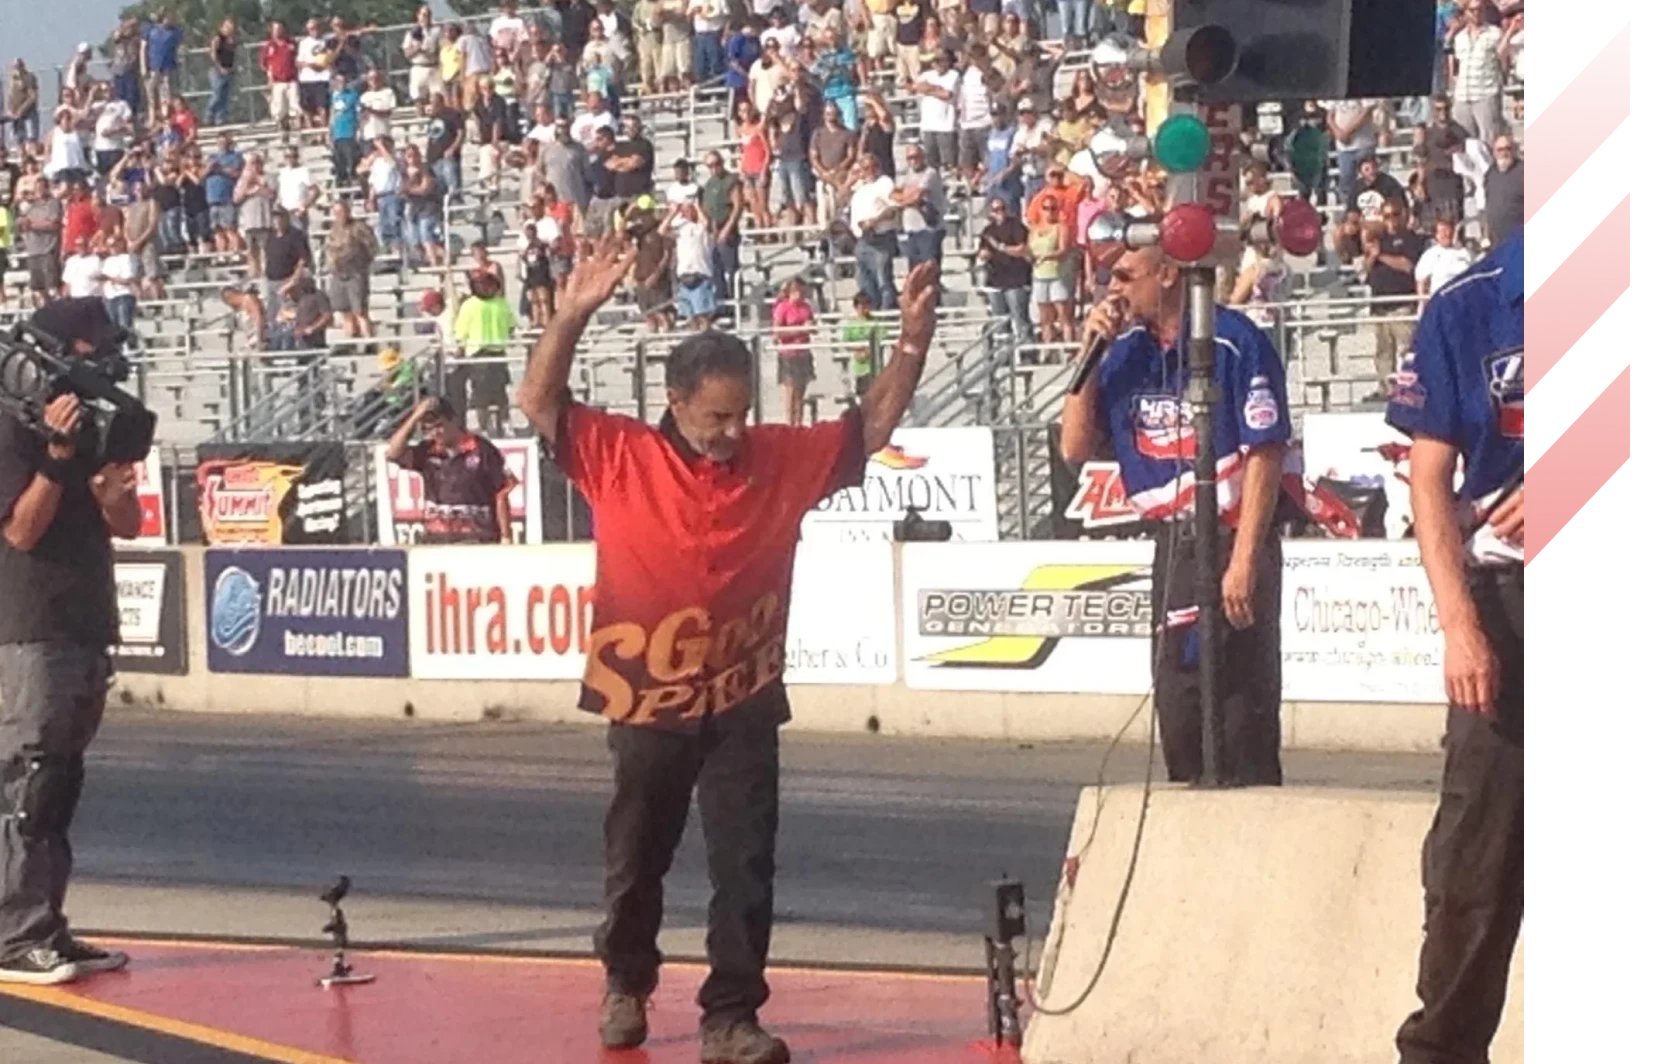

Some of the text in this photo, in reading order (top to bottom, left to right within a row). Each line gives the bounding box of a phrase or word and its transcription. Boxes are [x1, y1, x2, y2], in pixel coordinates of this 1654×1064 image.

[266, 567, 402, 619] RADIATORS
[924, 591, 1152, 621] POWER TECH
[284, 629, 383, 658] becool.com
